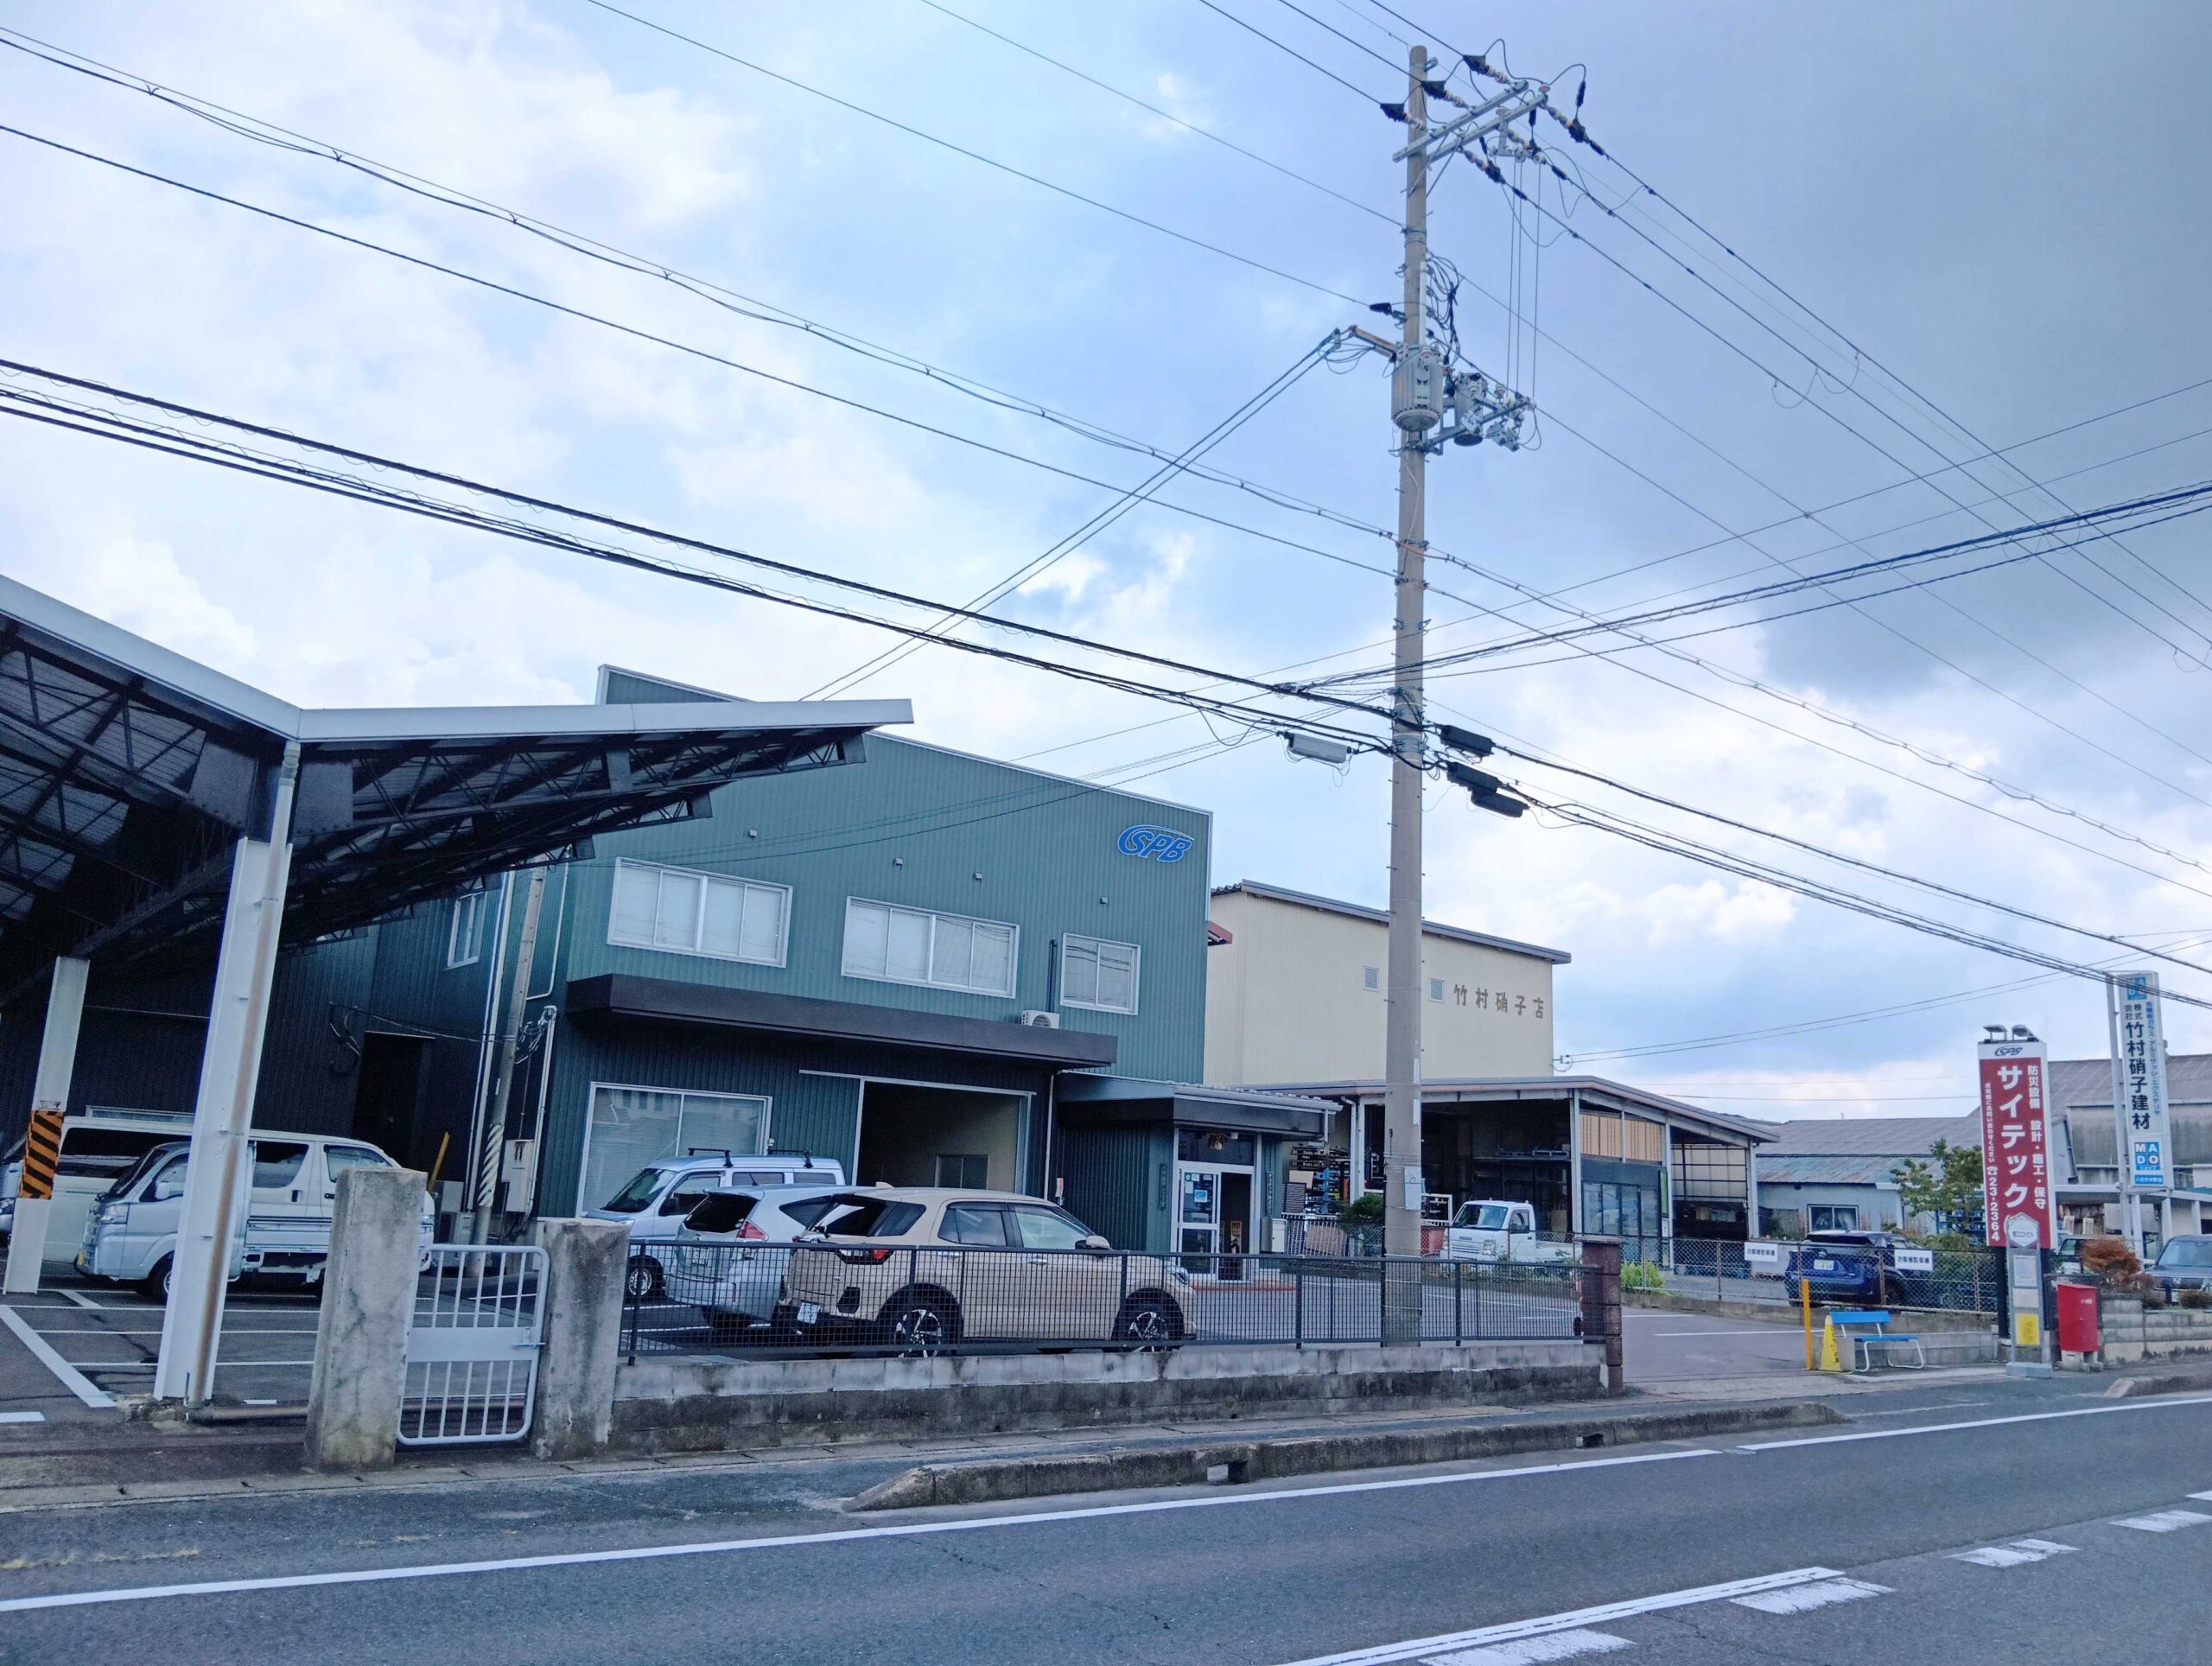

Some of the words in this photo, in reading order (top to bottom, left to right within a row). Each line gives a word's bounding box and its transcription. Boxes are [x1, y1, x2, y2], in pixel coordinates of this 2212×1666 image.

[2125, 1003, 2144, 1020] 株式会社
[2027, 1065, 2040, 1109] 防災設備
[2126, 1021, 2150, 1129] 竹村硝子建材
[1997, 1065, 2028, 1236] サイテック
[2031, 1120, 2046, 1209] 設計・施工・保守
